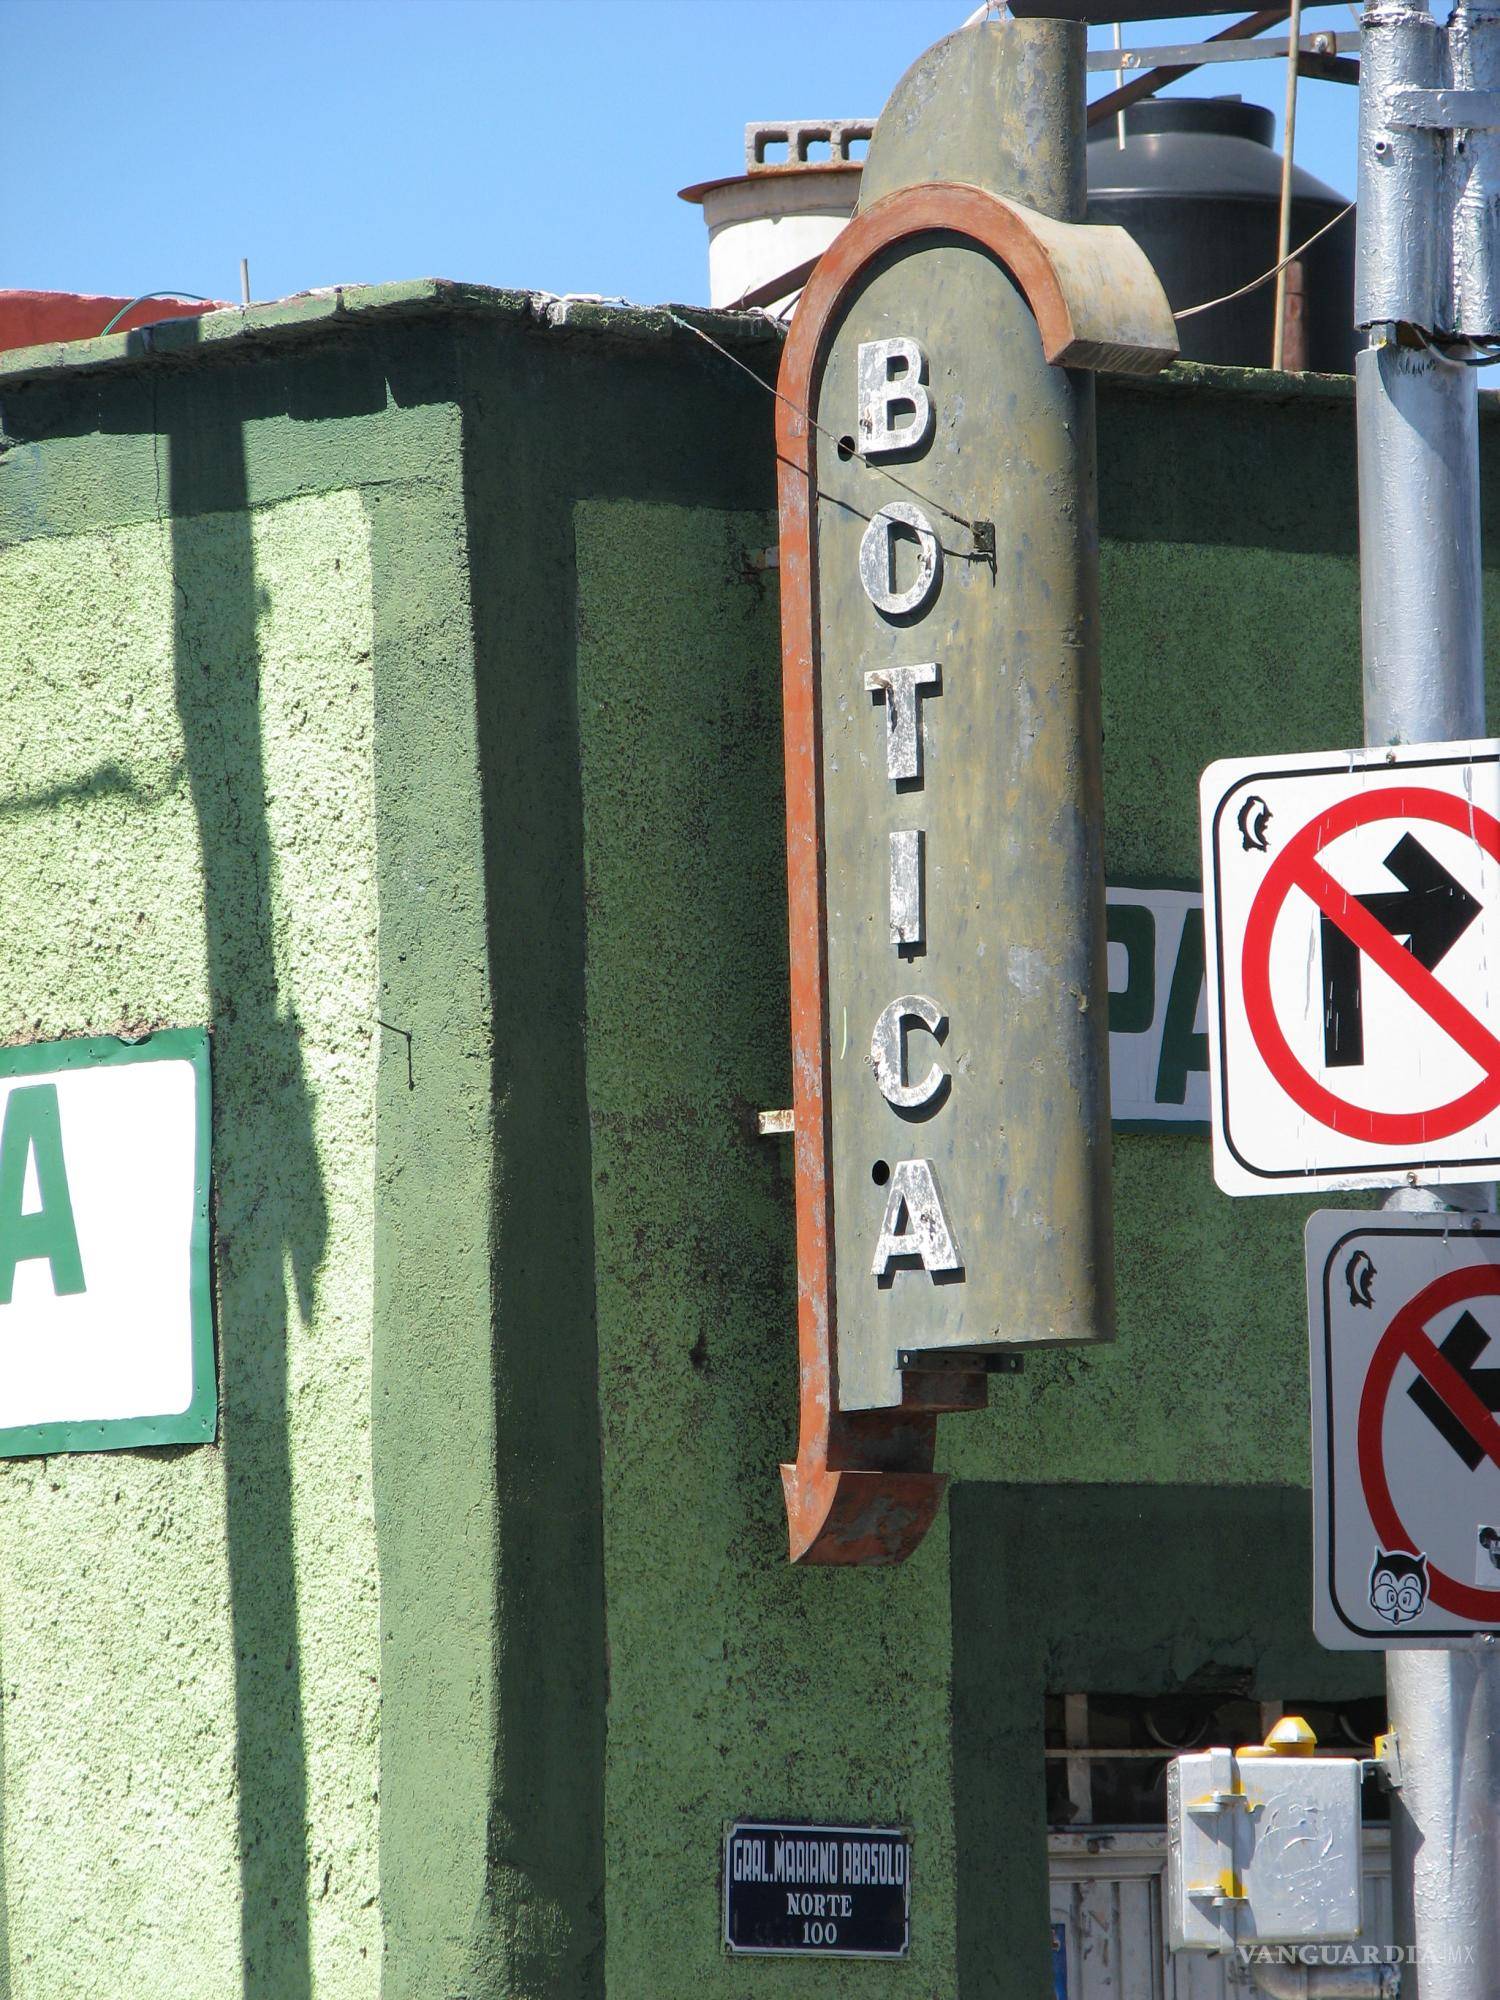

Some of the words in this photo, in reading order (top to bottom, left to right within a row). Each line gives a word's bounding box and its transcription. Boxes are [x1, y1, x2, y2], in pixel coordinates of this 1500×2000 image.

[858, 337, 960, 1276] BOTICA
[733, 1839, 773, 1882] GRAL.
[774, 1840, 838, 1884] MARIANO
[842, 1842, 904, 1885] ABASOLO
[786, 1892, 852, 1917] NORTE
[802, 1922, 837, 1944] 100
